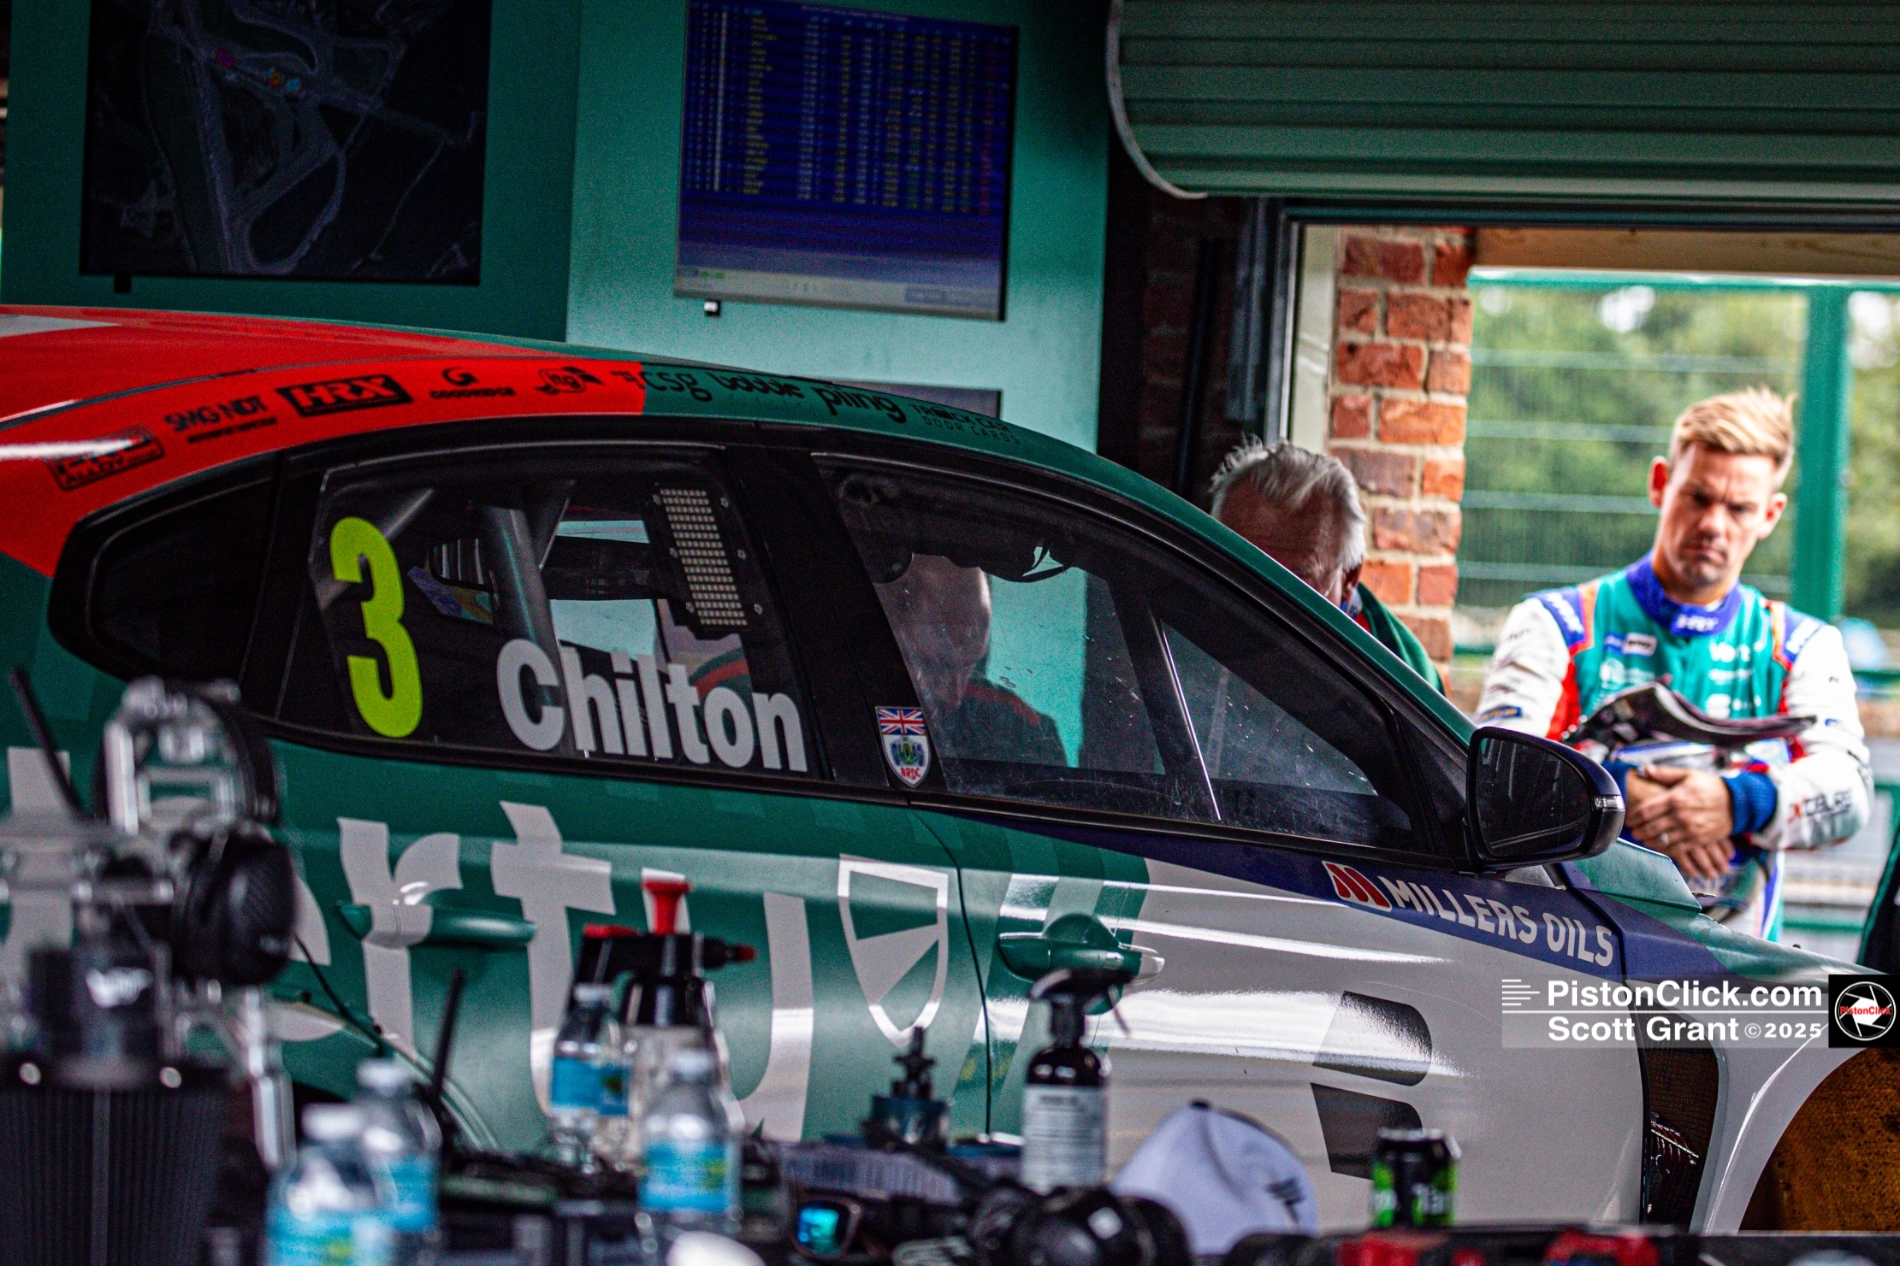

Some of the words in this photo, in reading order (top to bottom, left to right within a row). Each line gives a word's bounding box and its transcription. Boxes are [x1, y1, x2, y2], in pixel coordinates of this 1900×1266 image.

[288, 376, 397, 408] HRX
[329, 516, 423, 738] 3
[496, 637, 808, 773] Chilton
[900, 766, 922, 781] BRDC
[1377, 876, 1538, 944] MILLERS
[1542, 912, 1614, 967] OILS
